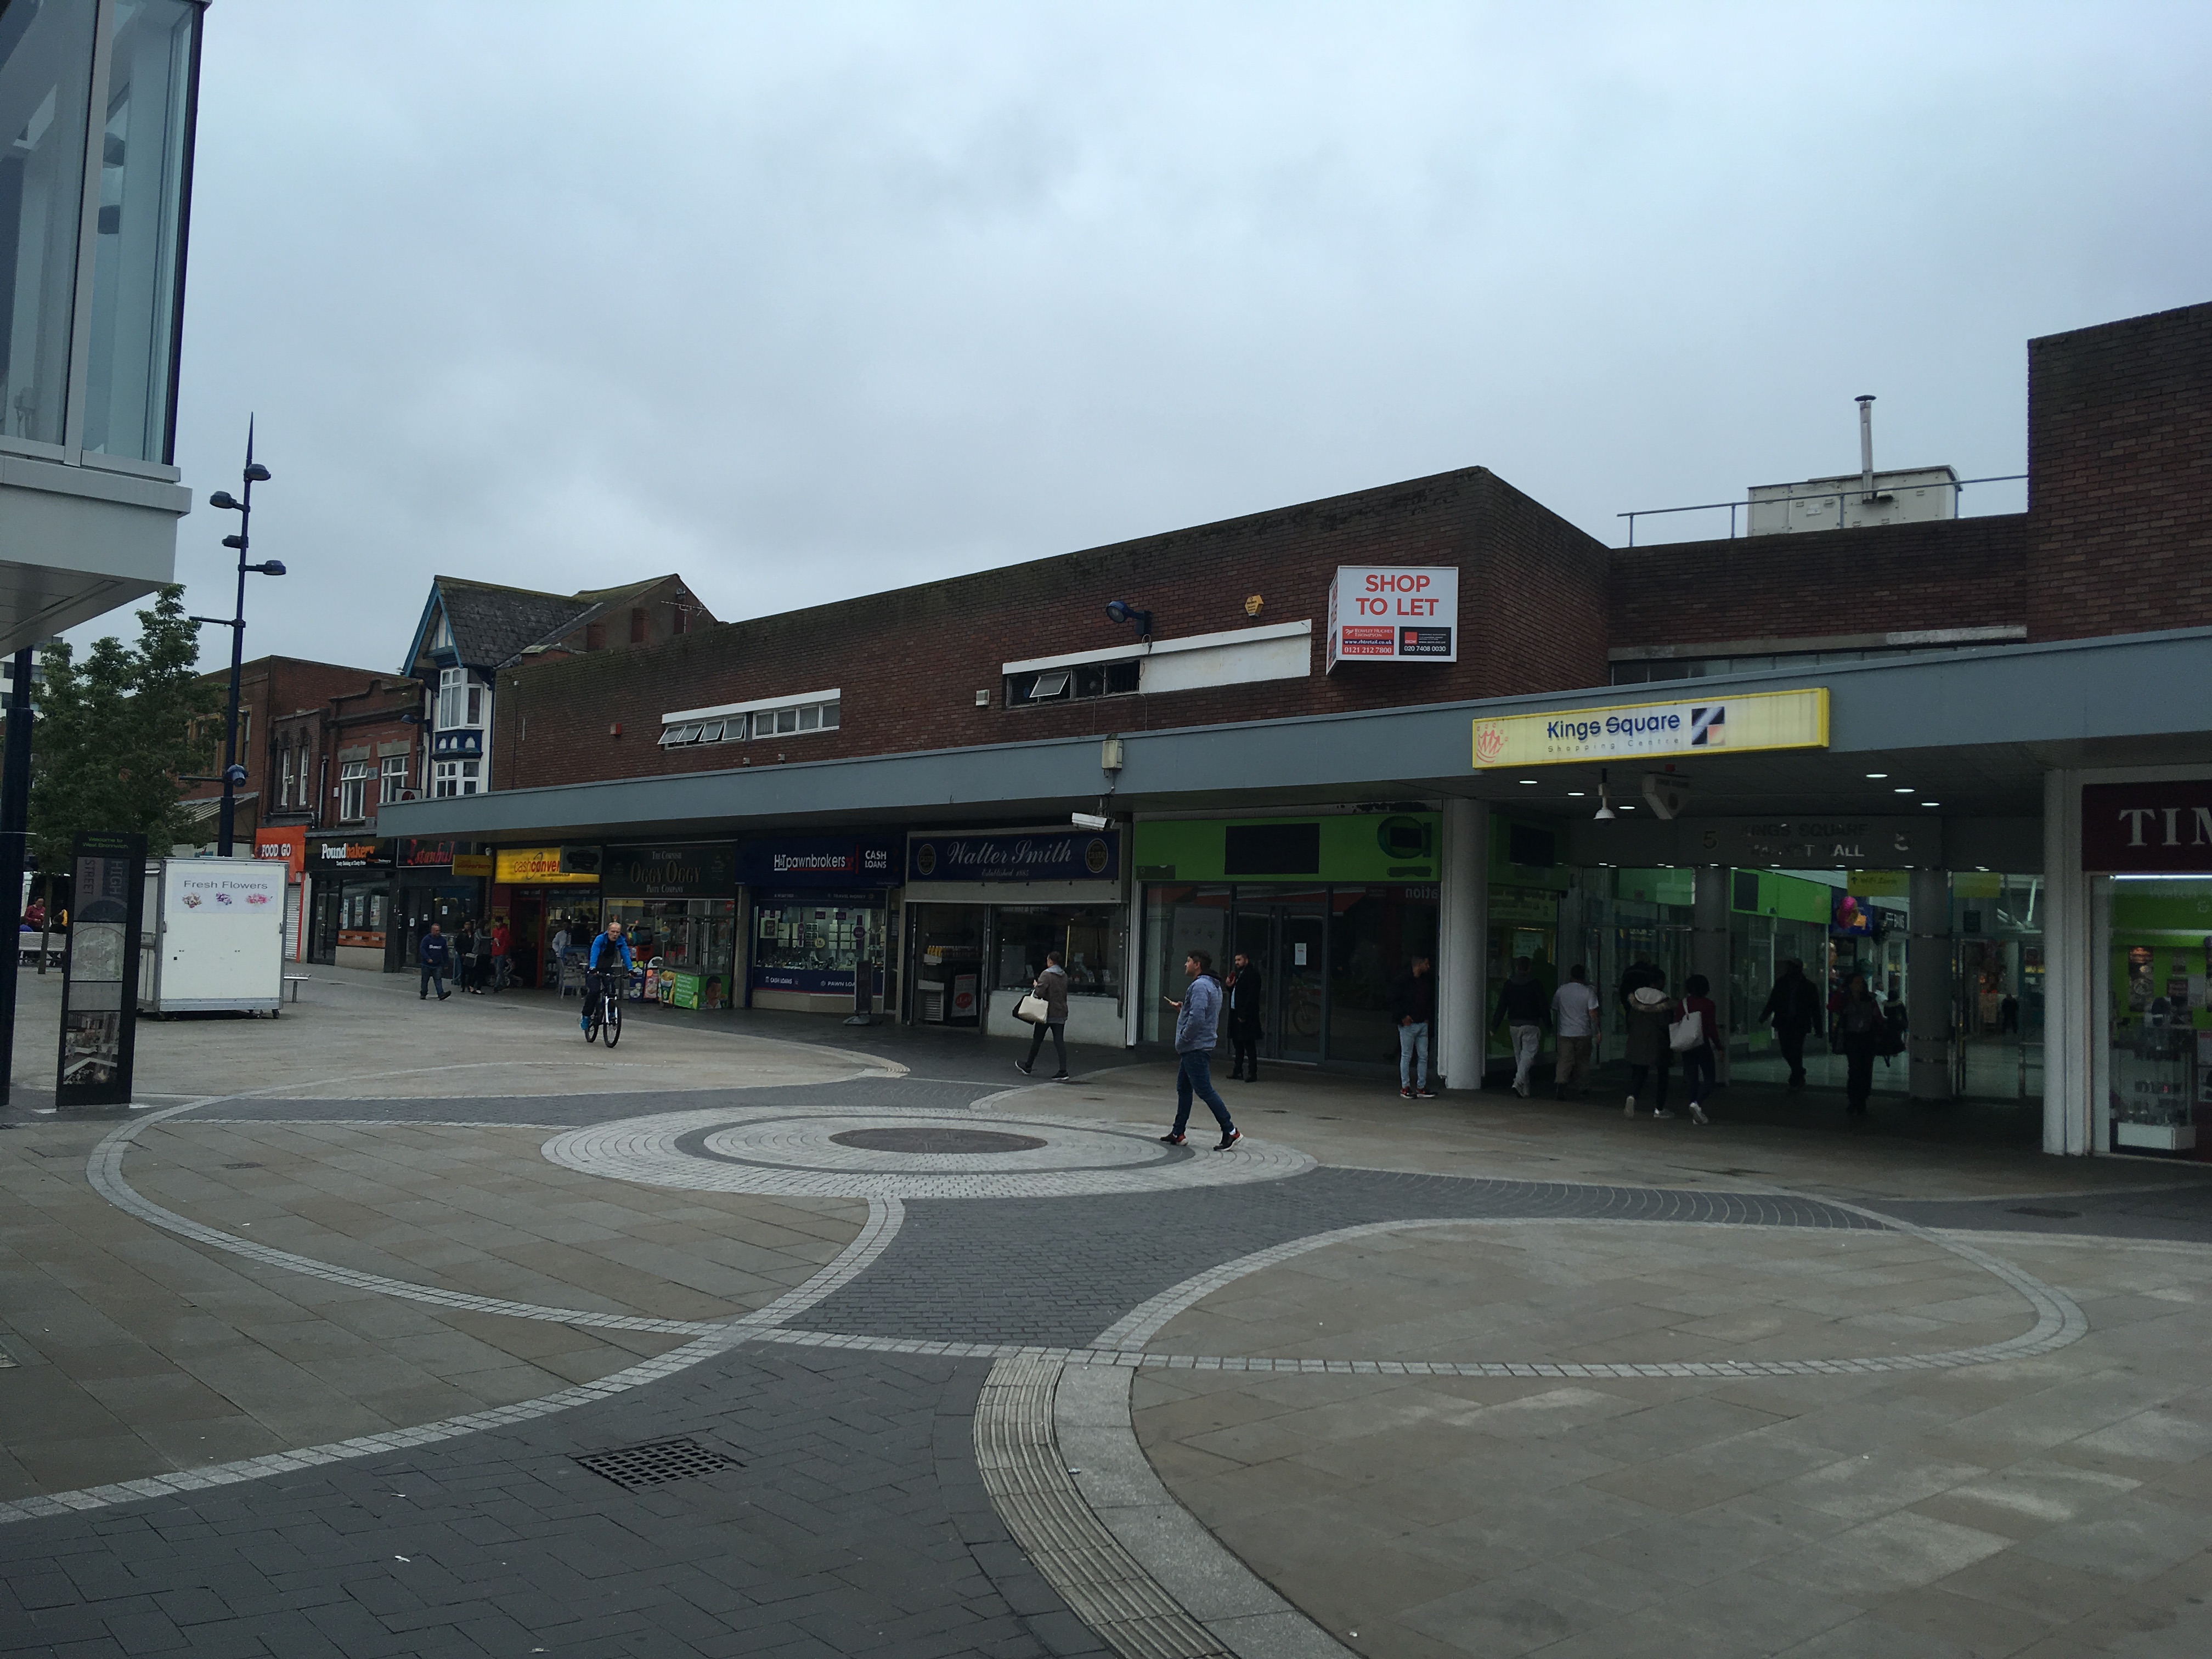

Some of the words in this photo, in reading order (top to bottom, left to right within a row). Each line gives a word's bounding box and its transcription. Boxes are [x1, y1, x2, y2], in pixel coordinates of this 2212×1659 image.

[1365, 574, 1430, 592] SHOP
[1356, 598, 1387, 616] TO
[1397, 599, 1439, 616] LET
[1547, 720, 1601, 741] Kings
[1605, 714, 1680, 736] Square
[1548, 742, 1615, 753] Shopping
[1628, 737, 1679, 747] Centre
[1741, 823, 1793, 837] KINGS
[1798, 823, 1869, 837] SQUARE
[1703, 830, 1718, 850] 5
[261, 844, 279, 857] FOOD
[281, 843, 291, 856] GO
[321, 842, 376, 860] Poundbakery
[652, 851, 661, 860] THE
[865, 850, 887, 860] CASH
[947, 841, 1009, 865] Walter
[1011, 838, 1073, 865] Smith
[865, 860, 887, 869] LOANS
[83, 859, 95, 895] STREET
[110, 860, 123, 895] HIGH
[184, 880, 218, 888] Fresh
[222, 881, 268, 889] Flowers
